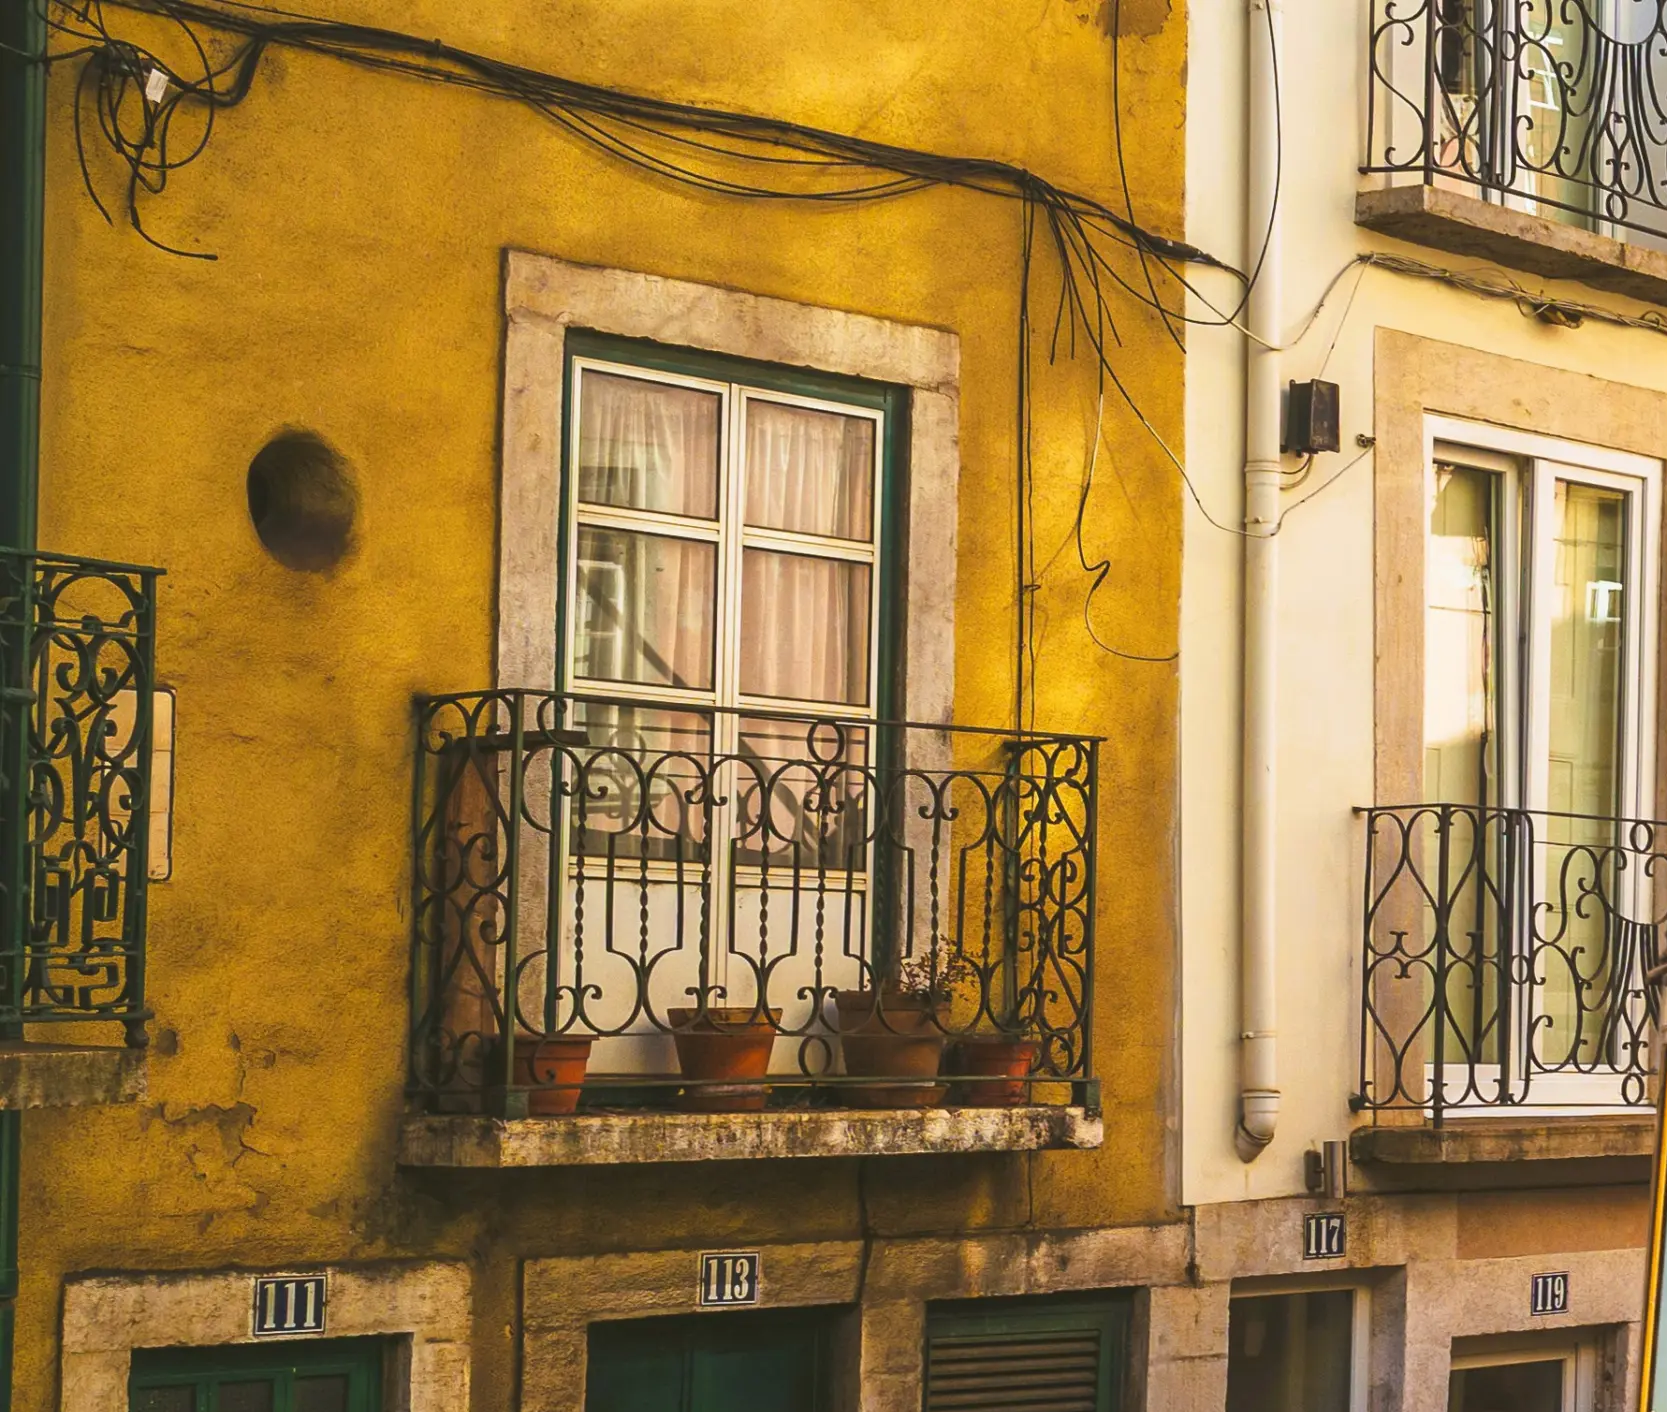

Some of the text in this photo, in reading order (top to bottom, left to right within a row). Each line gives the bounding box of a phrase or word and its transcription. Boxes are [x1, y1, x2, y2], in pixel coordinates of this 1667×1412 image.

[1308, 1218, 1341, 1254] 117
[708, 1258, 749, 1300] 113
[1536, 1276, 1565, 1311] 119
[263, 1281, 316, 1329] 111
